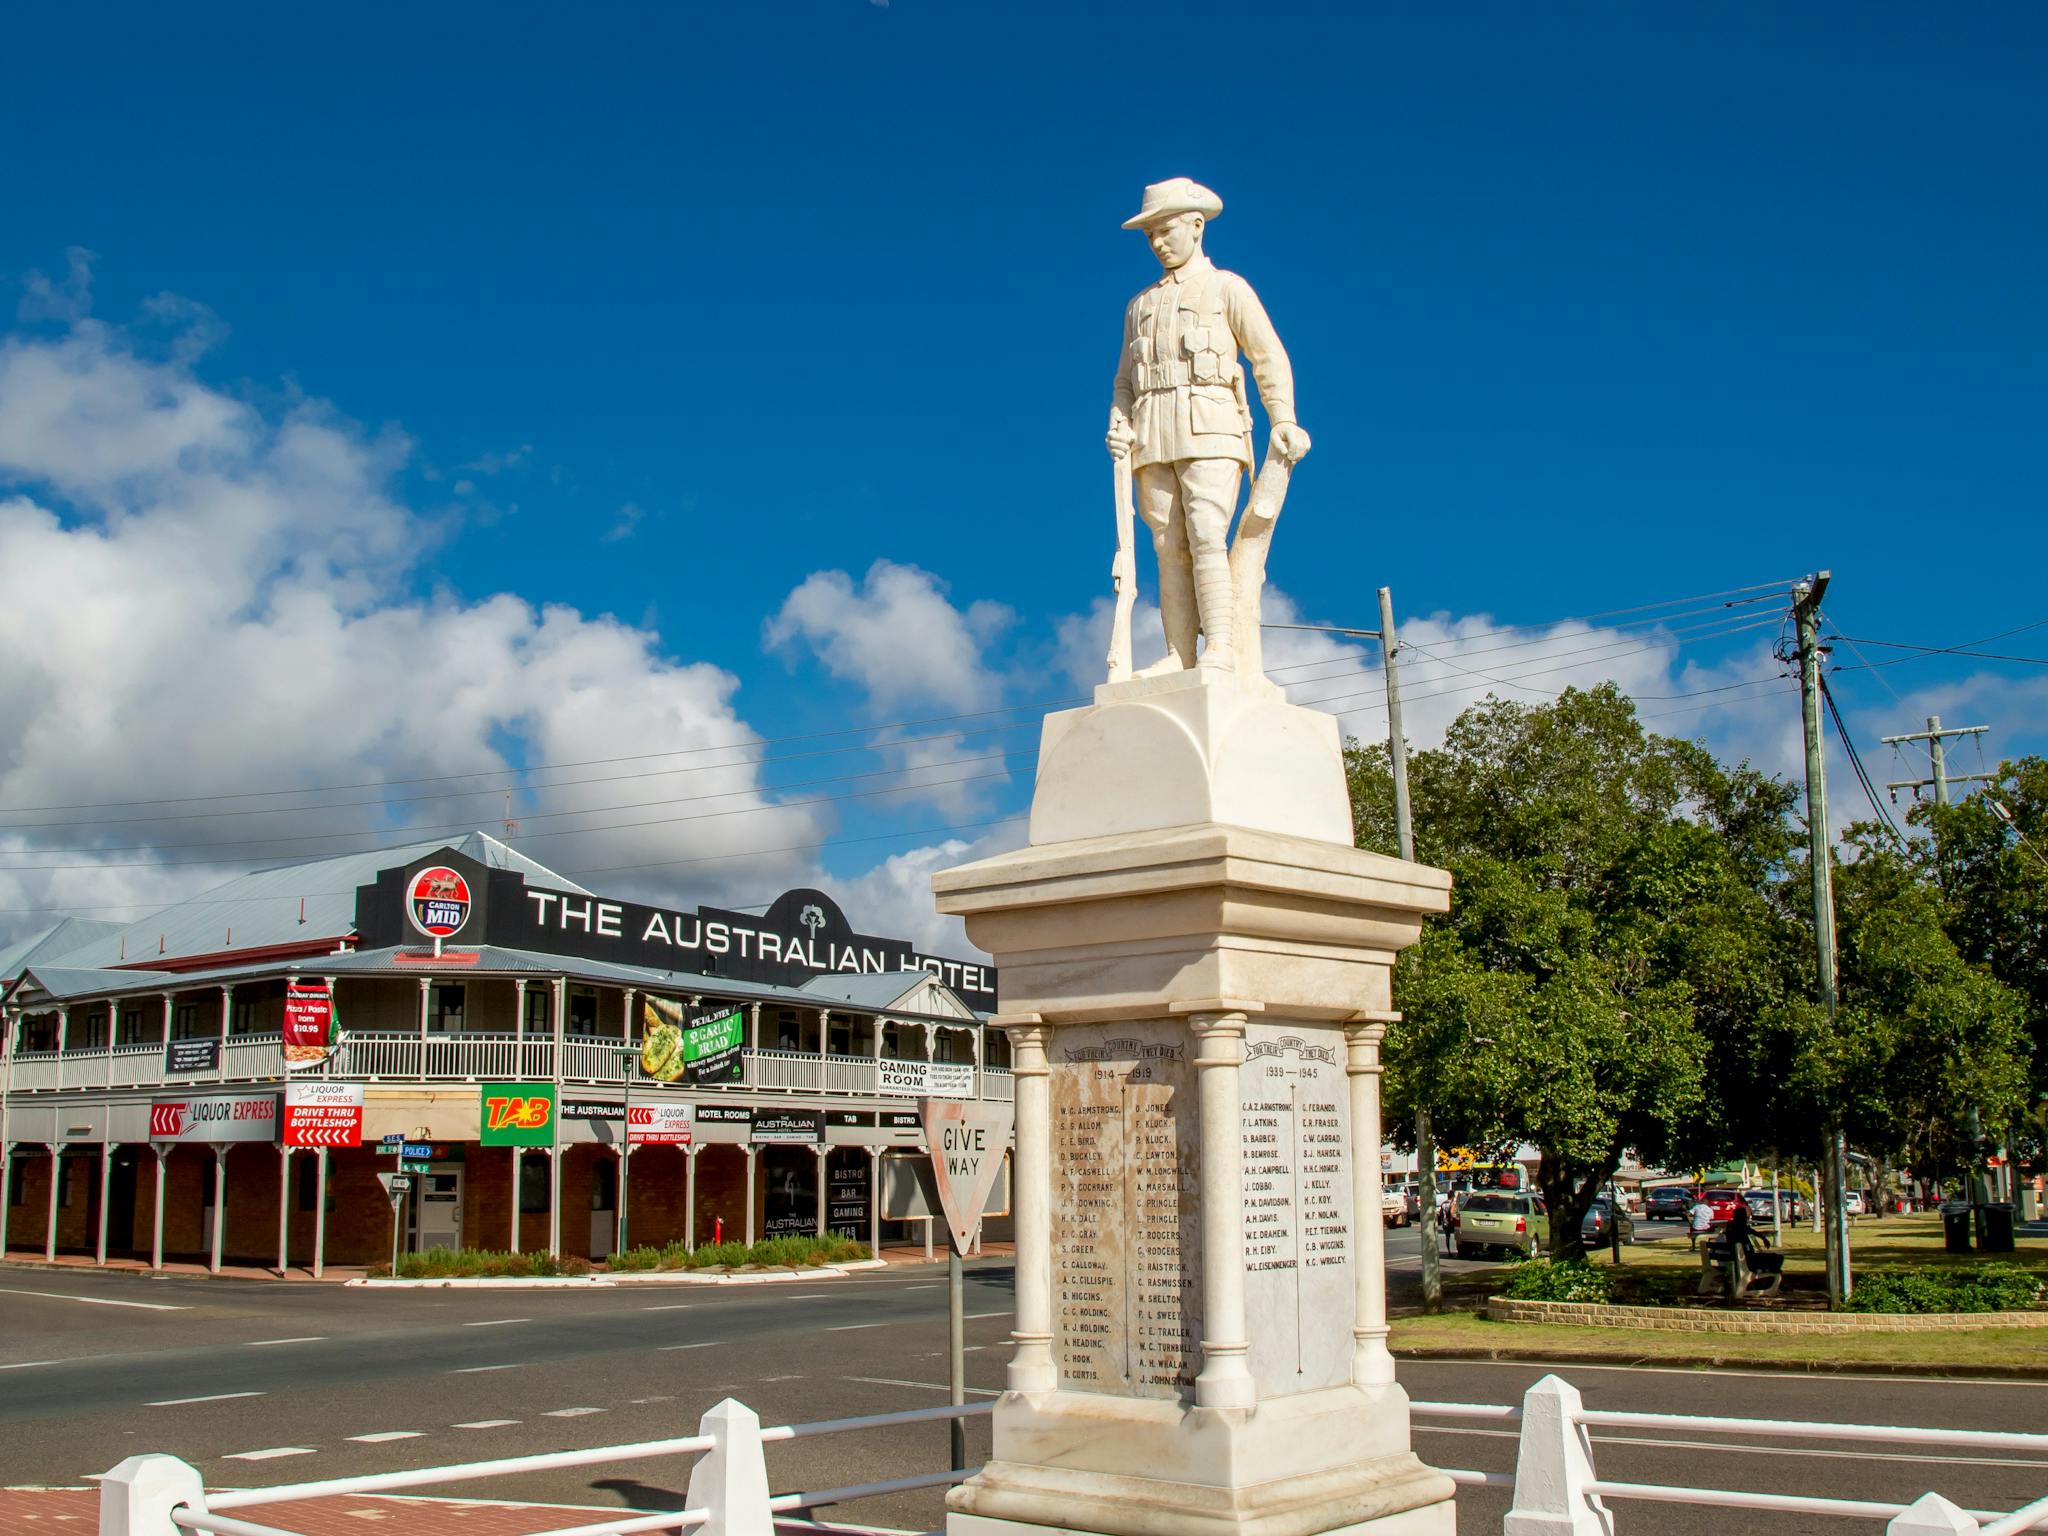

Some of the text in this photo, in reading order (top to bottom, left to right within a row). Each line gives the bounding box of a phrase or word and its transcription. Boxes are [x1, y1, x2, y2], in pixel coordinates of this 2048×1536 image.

[428, 901, 460, 911] CARLTON
[425, 909, 461, 926] MID
[527, 890, 995, 993] THE AUSTRALIAN HOTEL
[293, 1023, 319, 1033] $10.95
[699, 1018, 734, 1041] GARLIC
[1253, 1038, 1330, 1061] FOR THEIR COUNTRY THEY DIED
[879, 1061, 927, 1075] GAMING
[1094, 1067, 1152, 1080] 1914 1919
[1265, 1066, 1318, 1079] 1939 1945
[883, 1073, 924, 1087] ROOM
[310, 1085, 345, 1094] LIQUOR
[316, 1095, 353, 1103] EXPRESS
[192, 1100, 275, 1121] LIQUOR EXPRESS
[293, 1108, 355, 1117] DRIVE THRU
[485, 1097, 551, 1129] TAB
[560, 1104, 625, 1116] THE AUSTRALIAN
[660, 1108, 685, 1118] LIQUOR
[698, 1109, 750, 1119] MOTEL ROOMS
[290, 1118, 358, 1127] BOTTLESHOP
[664, 1119, 691, 1129] EXPRESS
[755, 1120, 815, 1128] AUSTRALIAN
[843, 1114, 857, 1124] TAB
[893, 1116, 916, 1125] BISTRO
[628, 1133, 691, 1142] DRIVE THRU BOTTLESHOP
[943, 1128, 986, 1151] GIVE
[404, 1146, 426, 1156] POLICE
[949, 1157, 980, 1176] WAY
[834, 1169, 863, 1179] BISTRO
[841, 1188, 857, 1199] BAR
[833, 1206, 864, 1218] GAMING
[765, 1217, 818, 1230] AUSTRALIAN
